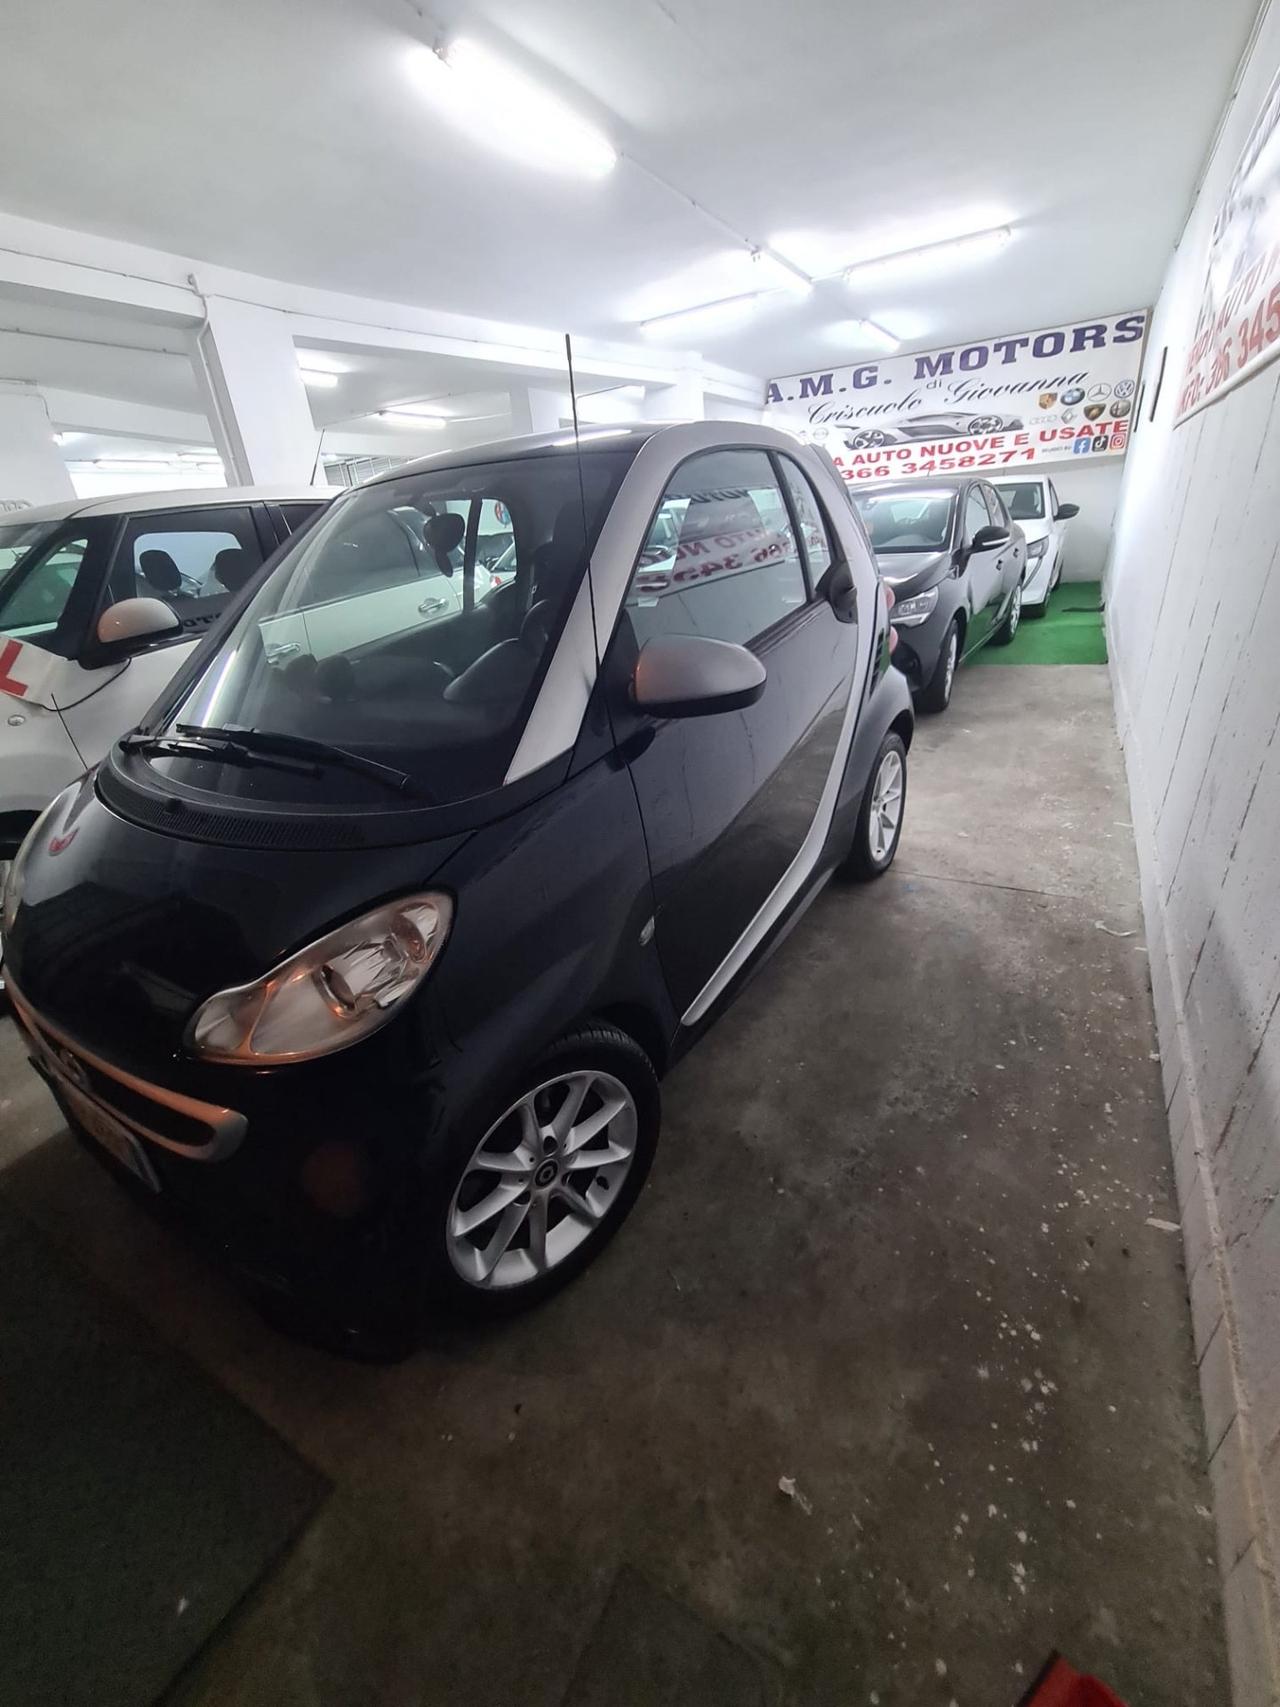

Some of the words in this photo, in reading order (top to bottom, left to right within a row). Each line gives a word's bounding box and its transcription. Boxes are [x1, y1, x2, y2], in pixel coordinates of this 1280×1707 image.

[765, 365, 892, 405] A.M.G.
[913, 315, 1146, 380] MOTORS
[807, 389, 923, 425] Criscuolo
[943, 371, 1089, 404] Giovanna
[926, 378, 942, 390] di
[841, 465, 891, 482] 366
[901, 448, 1036, 475] 3458271
[852, 449, 912, 466] AUTO
[920, 436, 1005, 458] NUOVE
[1014, 433, 1029, 446] E
[1039, 420, 1129, 443] USATE
